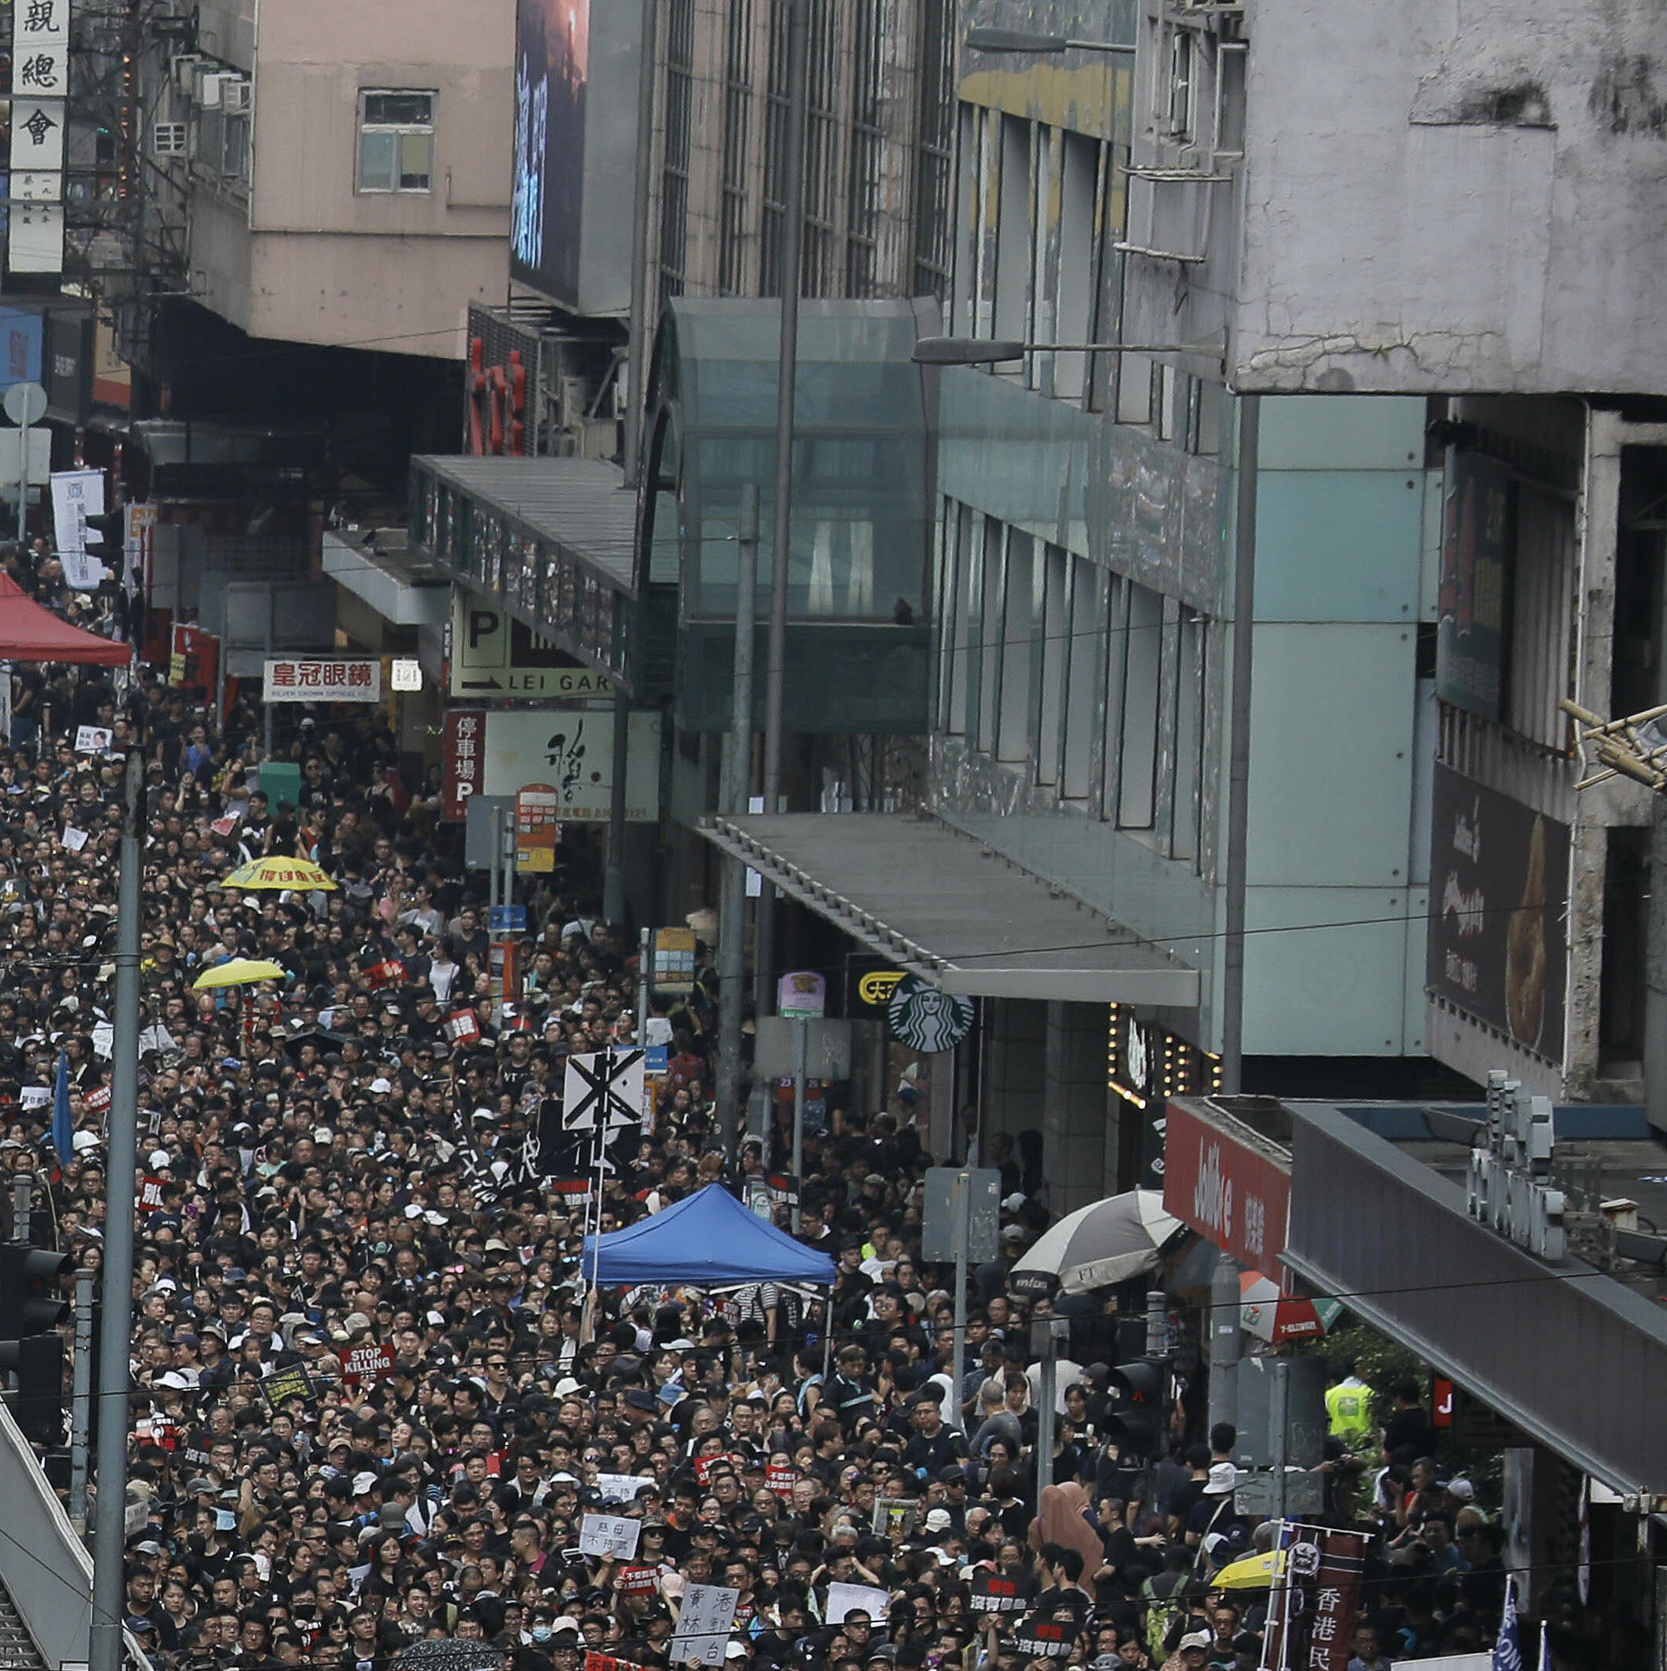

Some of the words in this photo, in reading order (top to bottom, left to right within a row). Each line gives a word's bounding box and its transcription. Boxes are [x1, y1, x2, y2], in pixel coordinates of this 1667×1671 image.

[470, 609, 499, 649] P
[272, 662, 372, 688] 皇冠眼鏡
[509, 674, 545, 689] LEI
[455, 715, 477, 781] 停車場
[457, 781, 473, 802] P
[350, 1346, 382, 1361] STOP
[343, 1356, 393, 1374] KILLING
[675, 1640, 719, 1660] 下台
